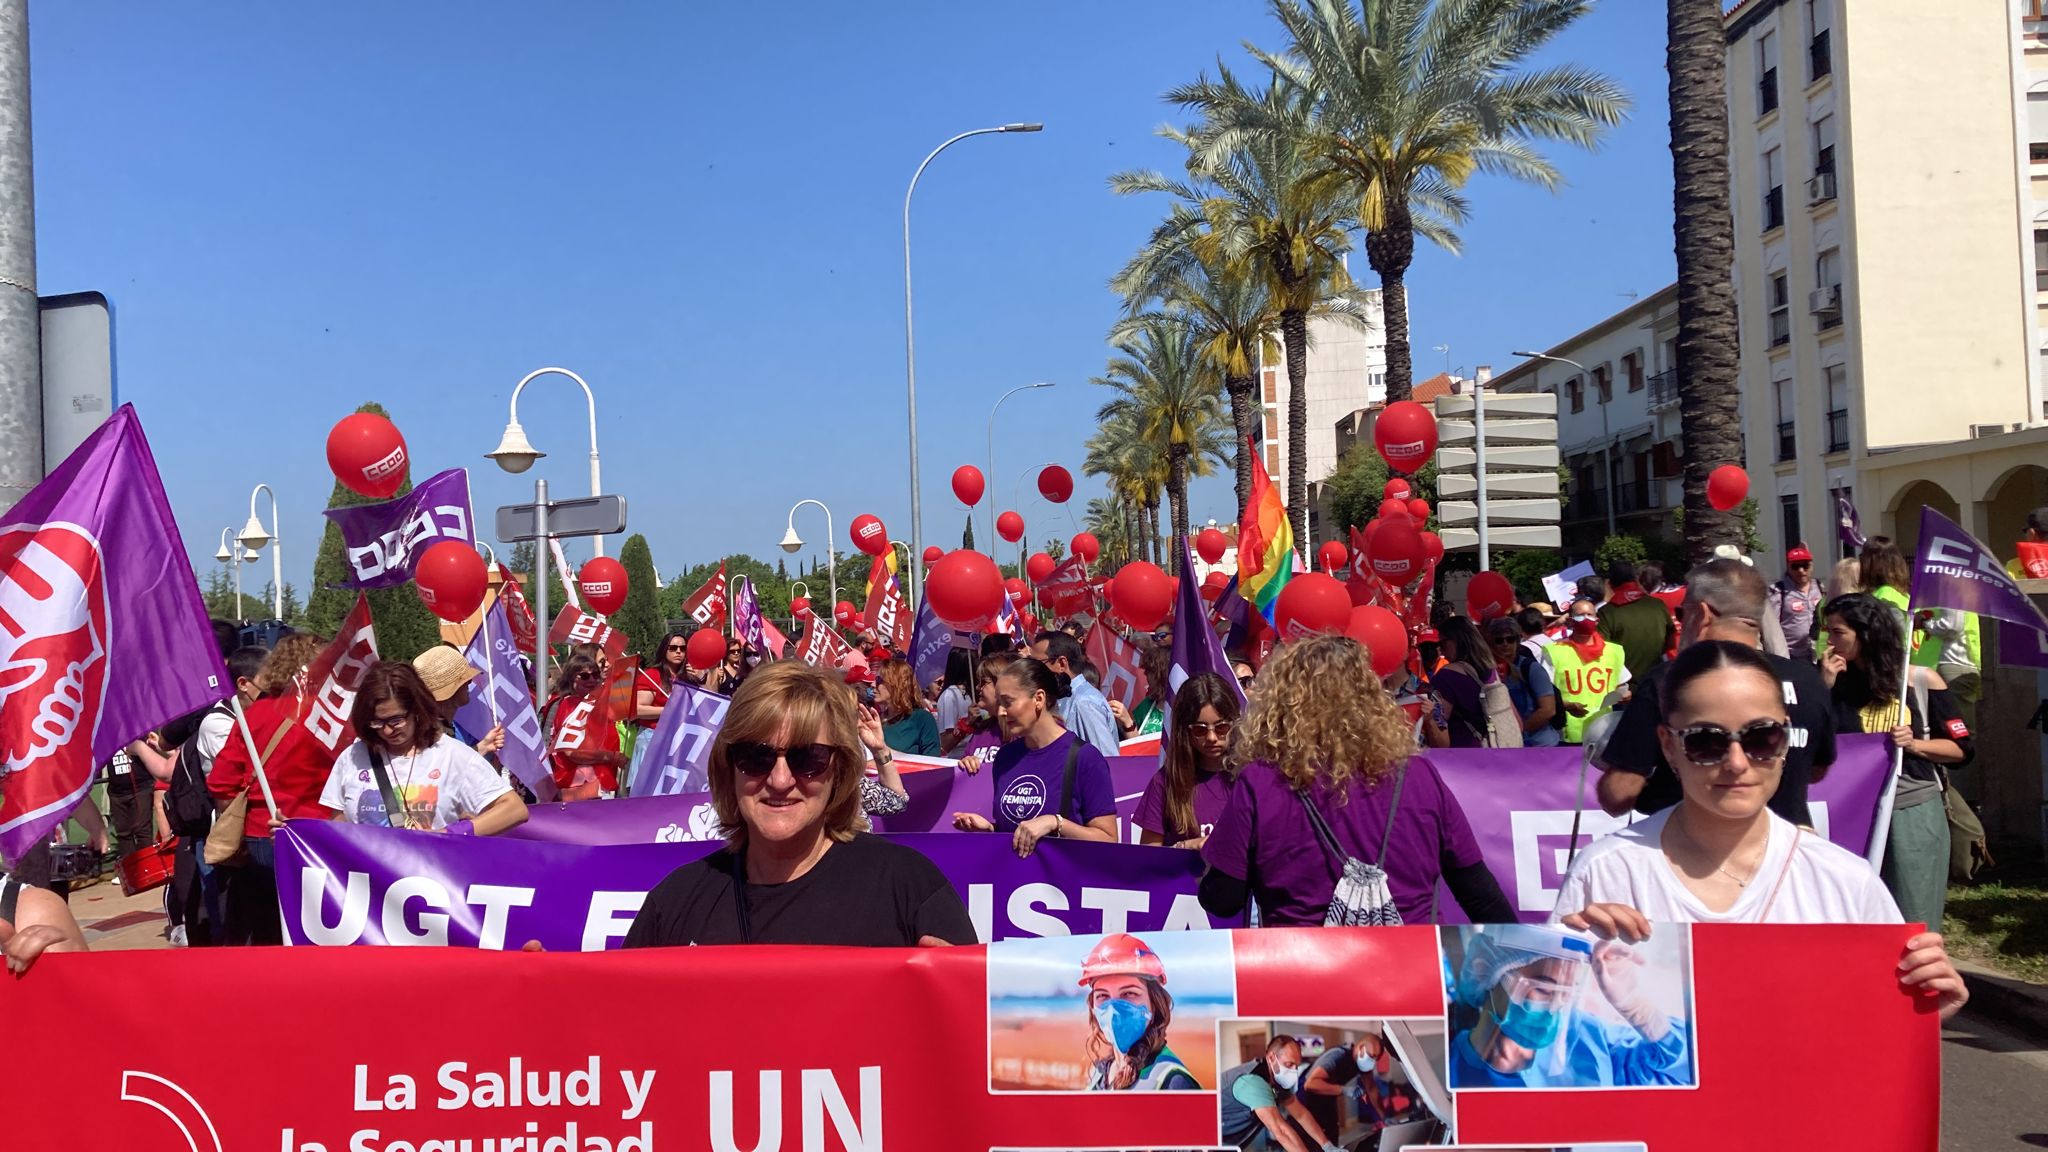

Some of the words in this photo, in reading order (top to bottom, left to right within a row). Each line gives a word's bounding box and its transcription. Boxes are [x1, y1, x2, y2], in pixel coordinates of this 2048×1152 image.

[366, 450, 405, 480] CCOO
[861, 523, 880, 536] CCOO
[1928, 536, 2013, 586] CC
[1924, 564, 2004, 588] mujeres
[583, 584, 609, 593] CCOO
[1565, 667, 1612, 696] UGT
[973, 745, 1001, 764] UG
[1003, 795, 1042, 805] FEMINISTA
[1017, 787, 1033, 796] UGT
[378, 803, 433, 812] OULLO
[301, 866, 536, 951] UGT
[354, 1065, 417, 1110] La
[437, 1056, 601, 1110] Salud
[620, 1070, 657, 1120] y
[709, 1066, 883, 1152] UN
